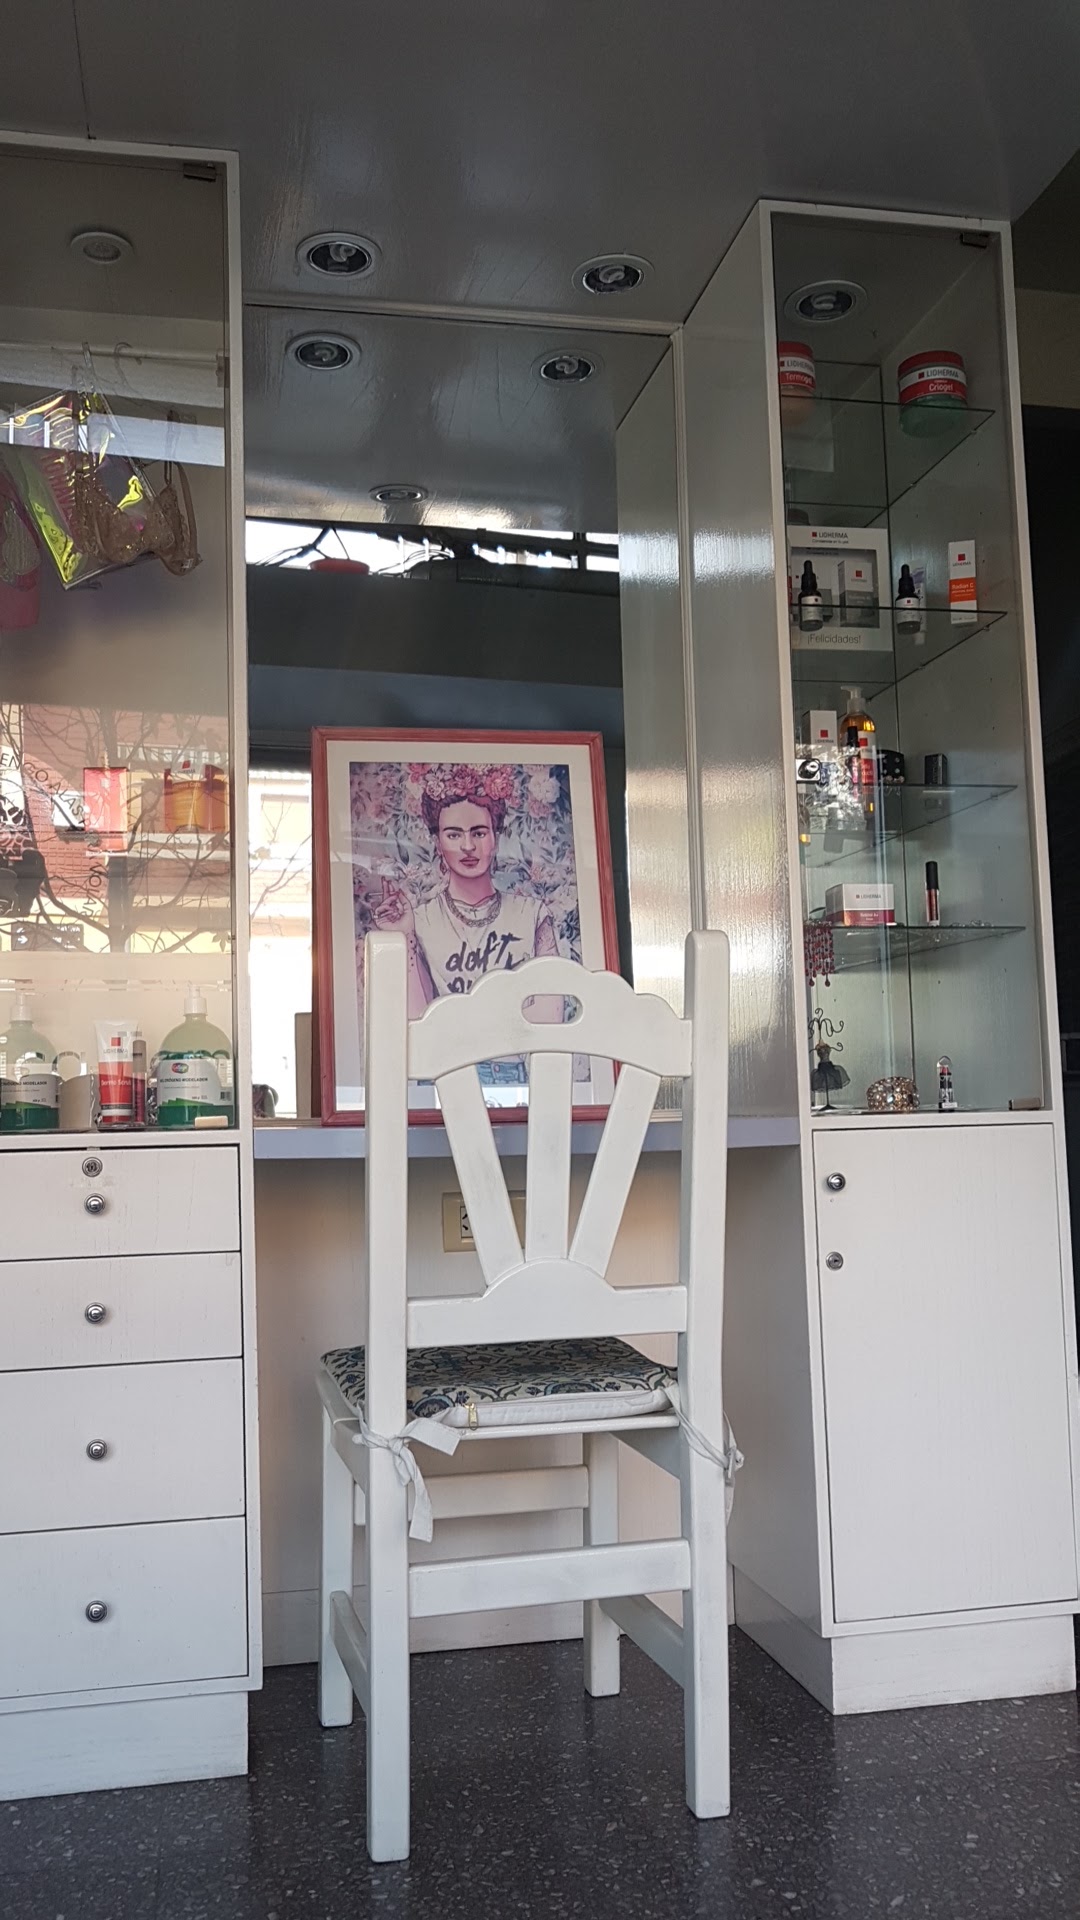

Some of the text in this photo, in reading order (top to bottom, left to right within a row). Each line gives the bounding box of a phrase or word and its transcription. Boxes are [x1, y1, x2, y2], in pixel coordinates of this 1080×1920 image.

[926, 369, 959, 378] LIDHERMA
[928, 383, 954, 392] Criogel
[807, 633, 861, 645] ¡Felicidades!
[51, 781, 84, 816] ALAS
